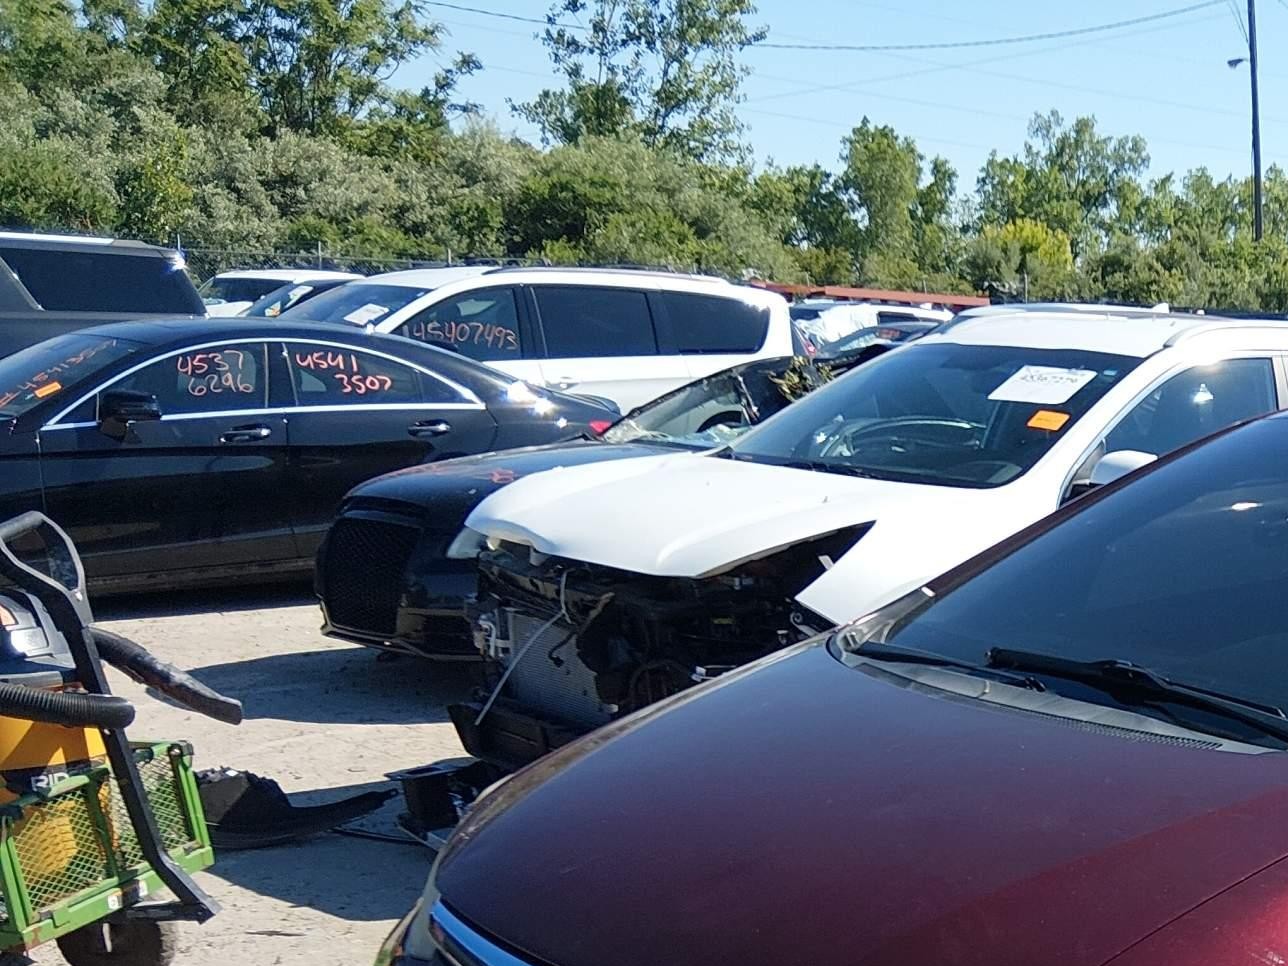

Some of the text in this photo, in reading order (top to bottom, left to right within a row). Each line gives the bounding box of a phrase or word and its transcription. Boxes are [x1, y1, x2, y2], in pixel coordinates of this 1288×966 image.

[411, 320, 520, 349] 45407493
[176, 350, 244, 376] 4537
[295, 351, 358, 372] 4541
[187, 373, 255, 396] 6296
[334, 374, 393, 395] 3507
